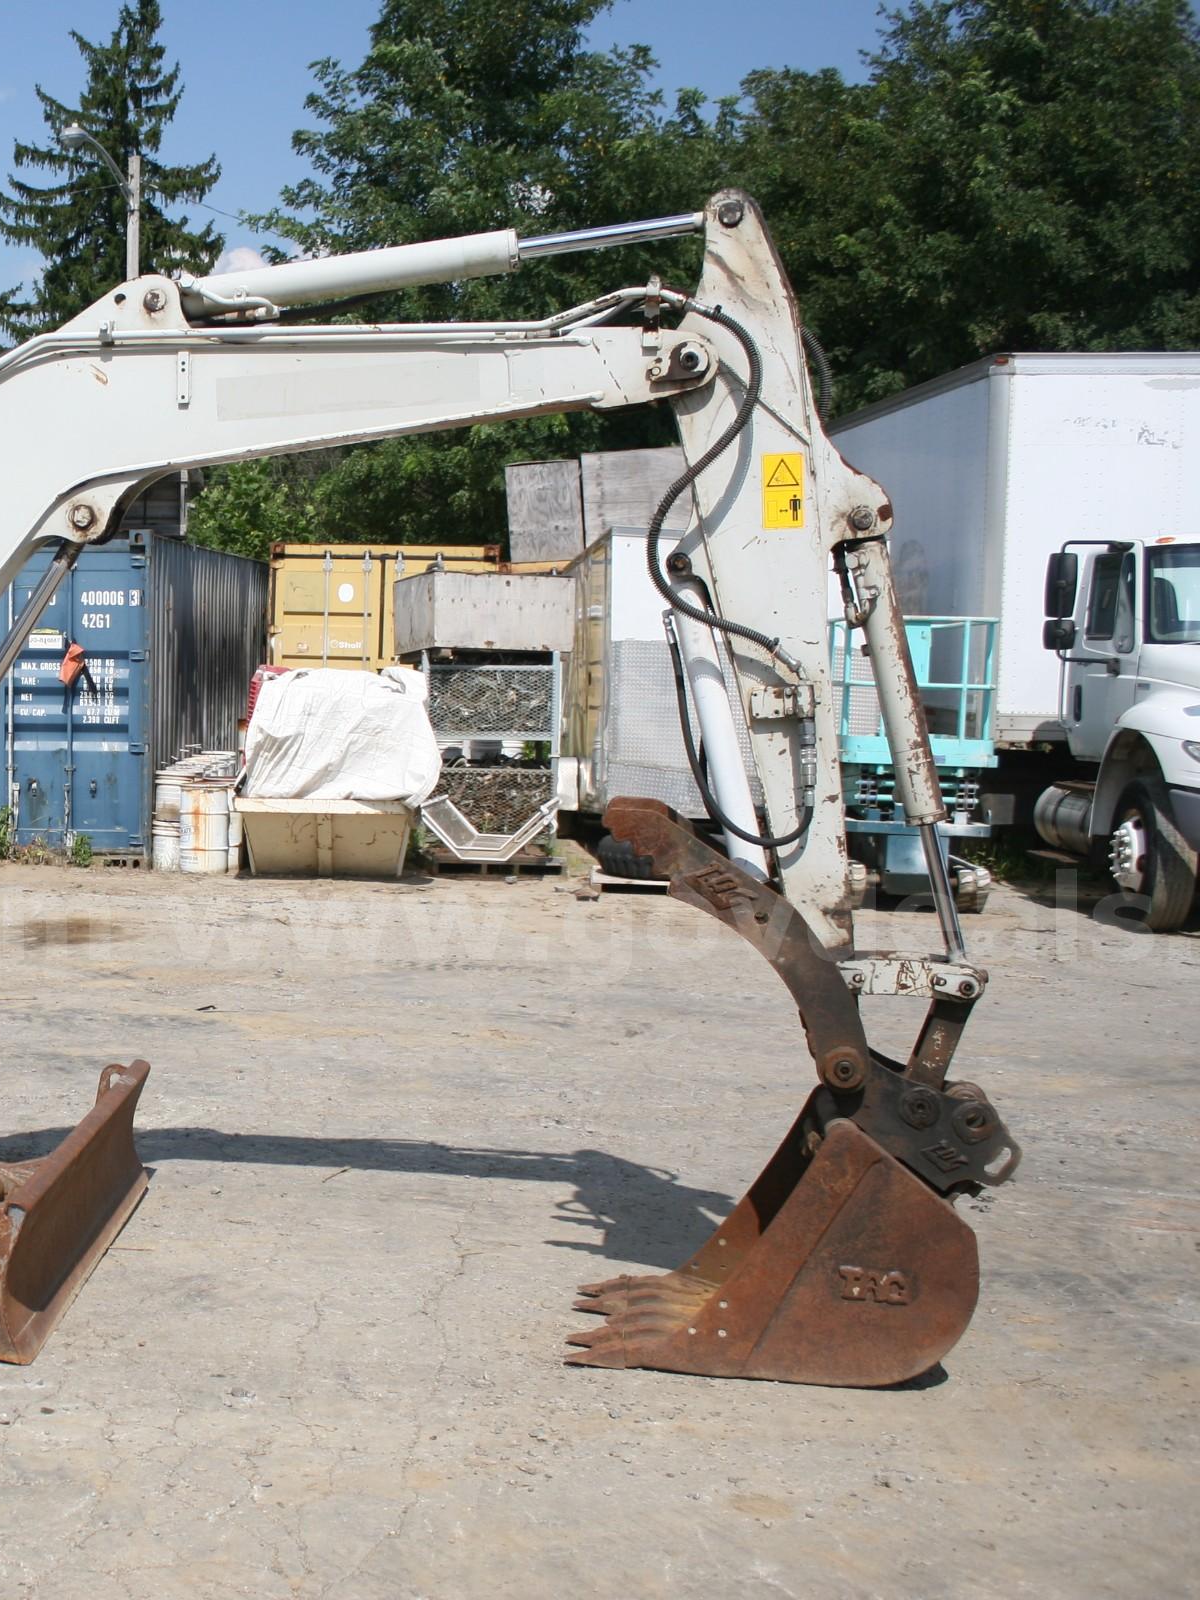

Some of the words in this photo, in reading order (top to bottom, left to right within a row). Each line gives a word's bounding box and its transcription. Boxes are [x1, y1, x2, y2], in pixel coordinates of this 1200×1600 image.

[81, 591, 124, 606] 400006
[81, 614, 111, 629] 42G1
[40, 662, 61, 671] GROSS
